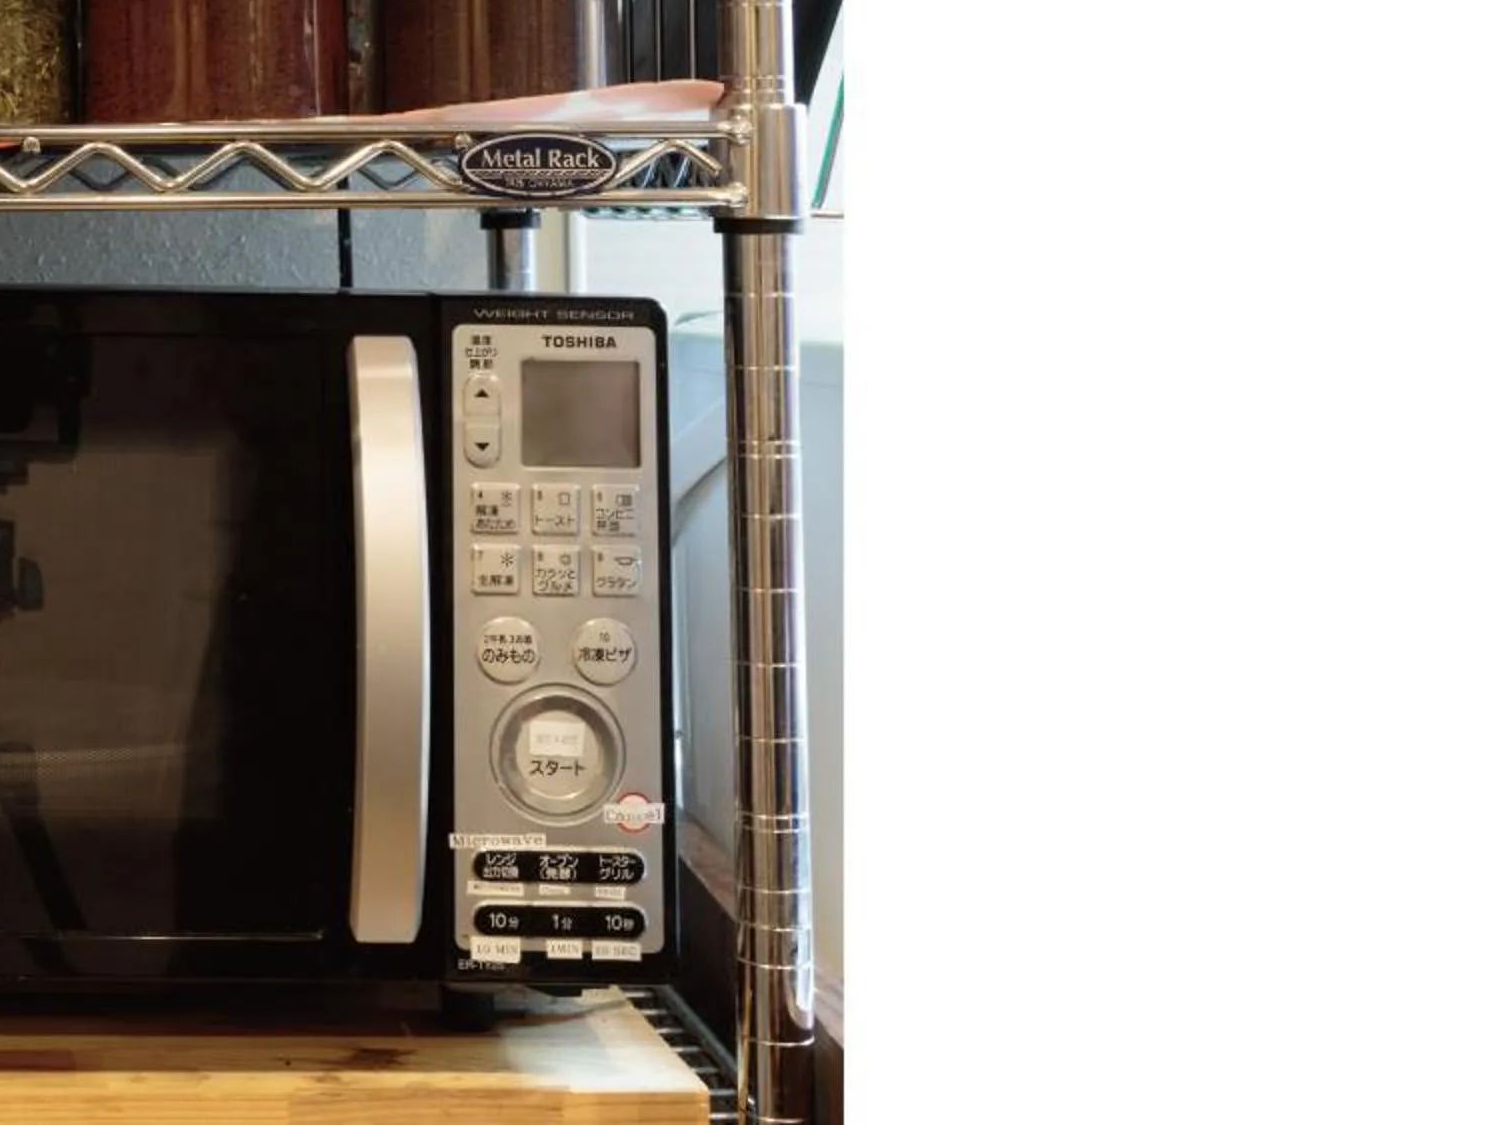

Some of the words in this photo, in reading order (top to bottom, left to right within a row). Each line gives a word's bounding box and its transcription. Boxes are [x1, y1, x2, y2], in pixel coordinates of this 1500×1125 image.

[481, 148, 541, 168] Metal
[548, 146, 601, 168] Rack
[473, 309, 548, 320] WEIGHT
[556, 309, 635, 321] SENSOR
[541, 335, 617, 348] TOSHIBA
[535, 515, 576, 526] トースト
[596, 508, 634, 520] コンビニ
[482, 648, 535, 664] のみもの
[579, 647, 632, 663] 冷凍ピザ
[530, 759, 586, 776] スタート
[540, 854, 579, 867] オーブン
[600, 855, 637, 867] トースター
[600, 868, 634, 880] グリル
[488, 913, 519, 929] 10分
